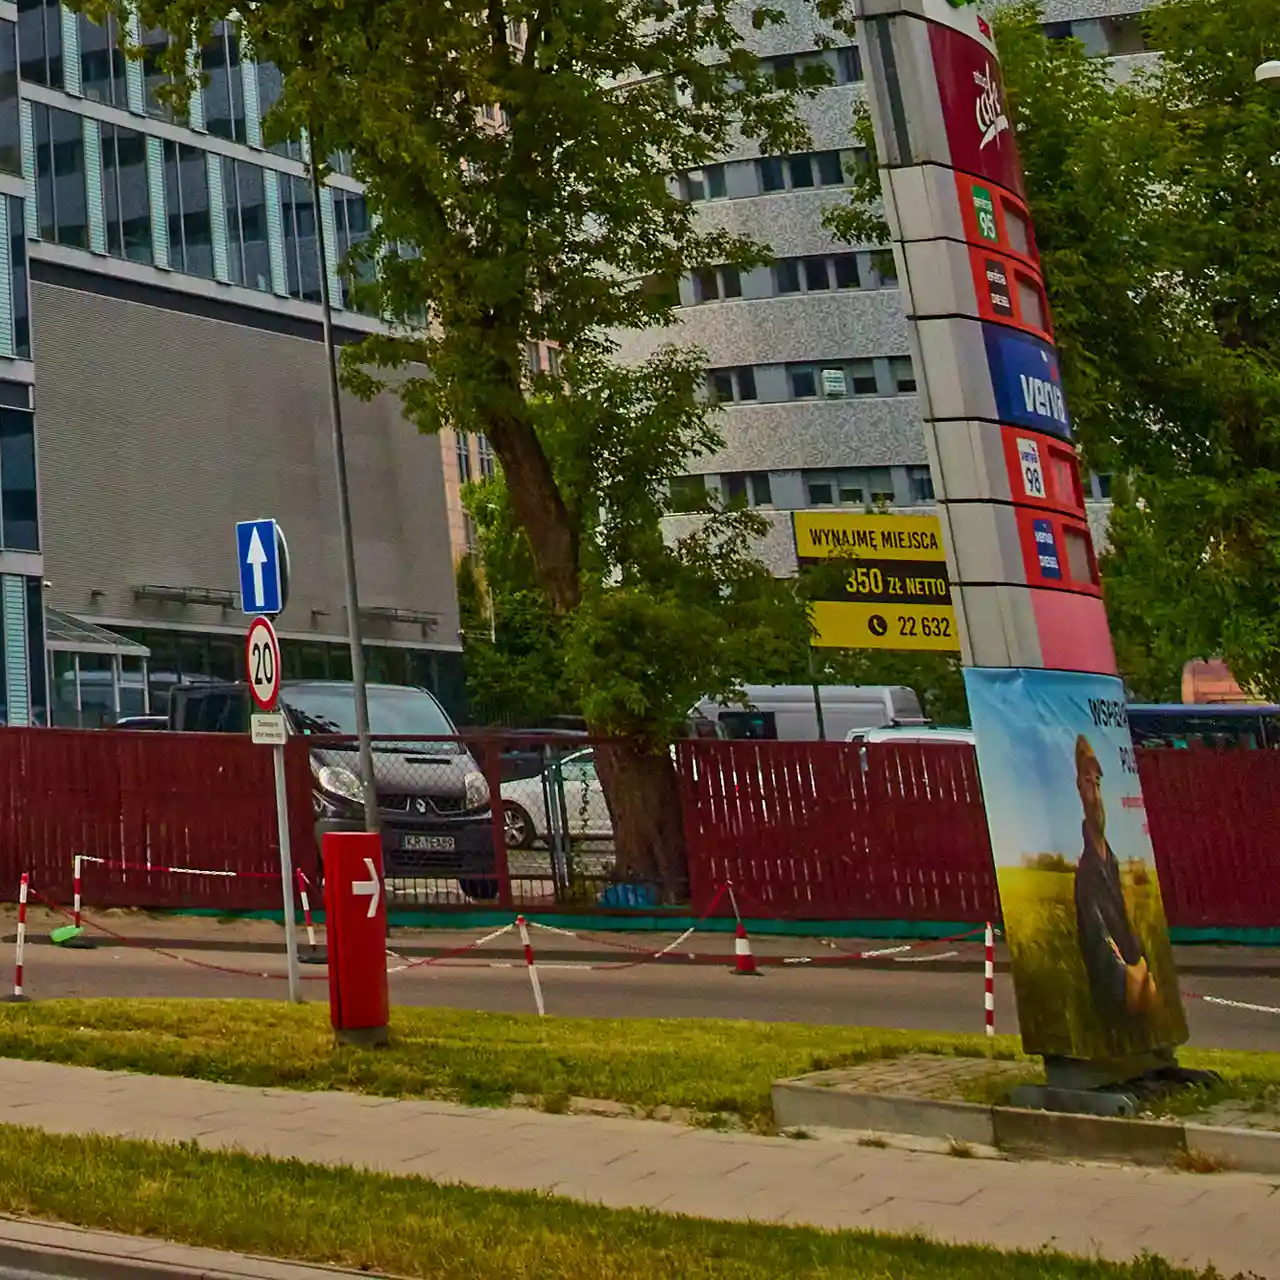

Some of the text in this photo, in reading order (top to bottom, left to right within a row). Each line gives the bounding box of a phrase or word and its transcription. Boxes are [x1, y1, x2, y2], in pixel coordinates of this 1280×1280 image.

[980, 211, 996, 239] 95
[1025, 467, 1041, 494] 98
[809, 528, 939, 551] WYNAJMĘ MIEJSCA
[887, 577, 904, 594] ZŁ
[905, 578, 946, 596] NETTO
[897, 616, 951, 637] 22 632
[252, 642, 274, 685] 20
